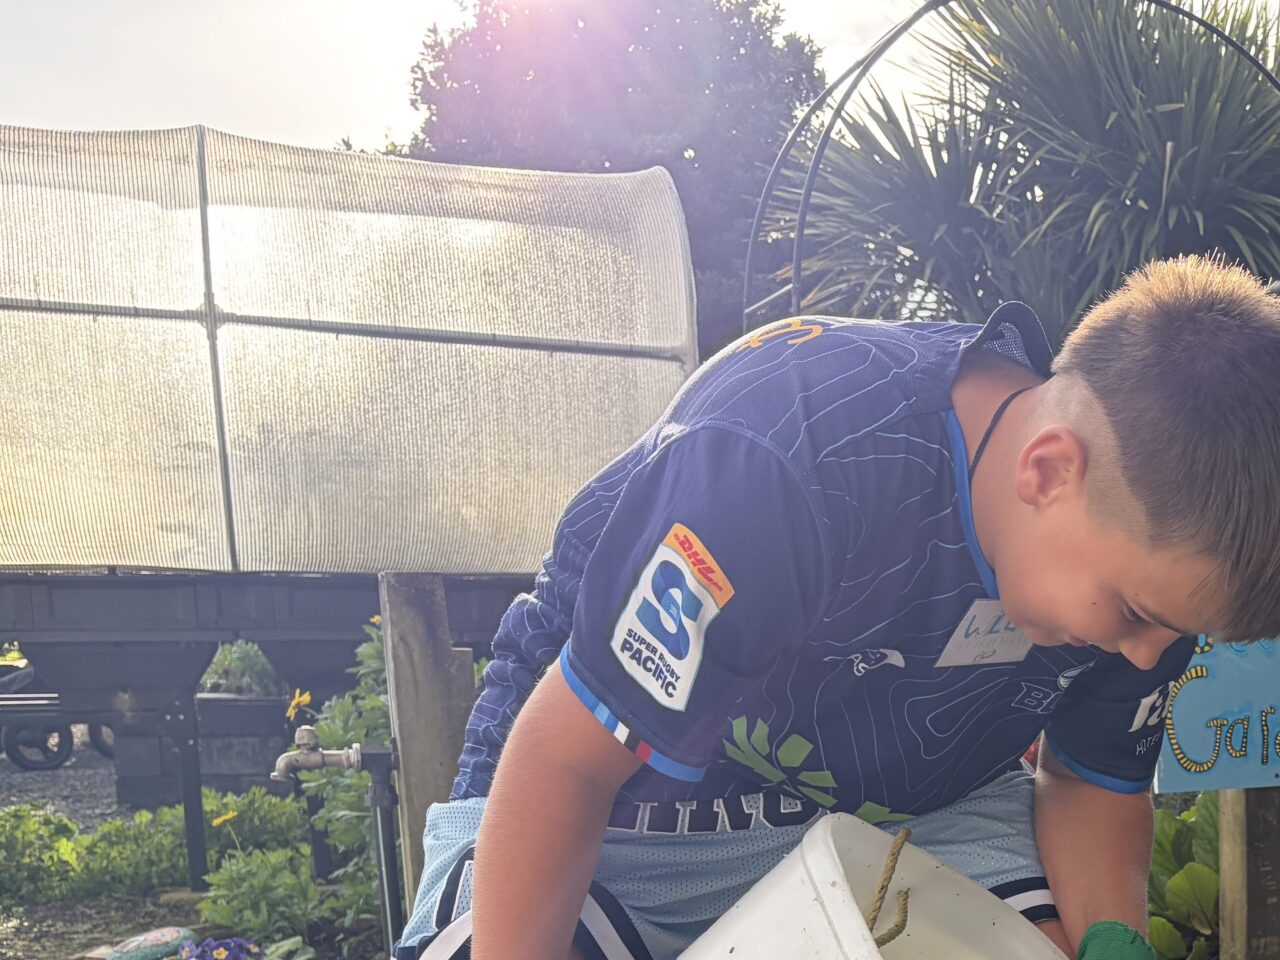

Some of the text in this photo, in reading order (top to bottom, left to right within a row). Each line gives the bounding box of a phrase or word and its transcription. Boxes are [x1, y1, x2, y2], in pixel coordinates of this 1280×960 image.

[675, 533, 724, 593] DHL
[620, 638, 678, 699] PACIFIC
[626, 628, 681, 683] SUPER RUGBY
